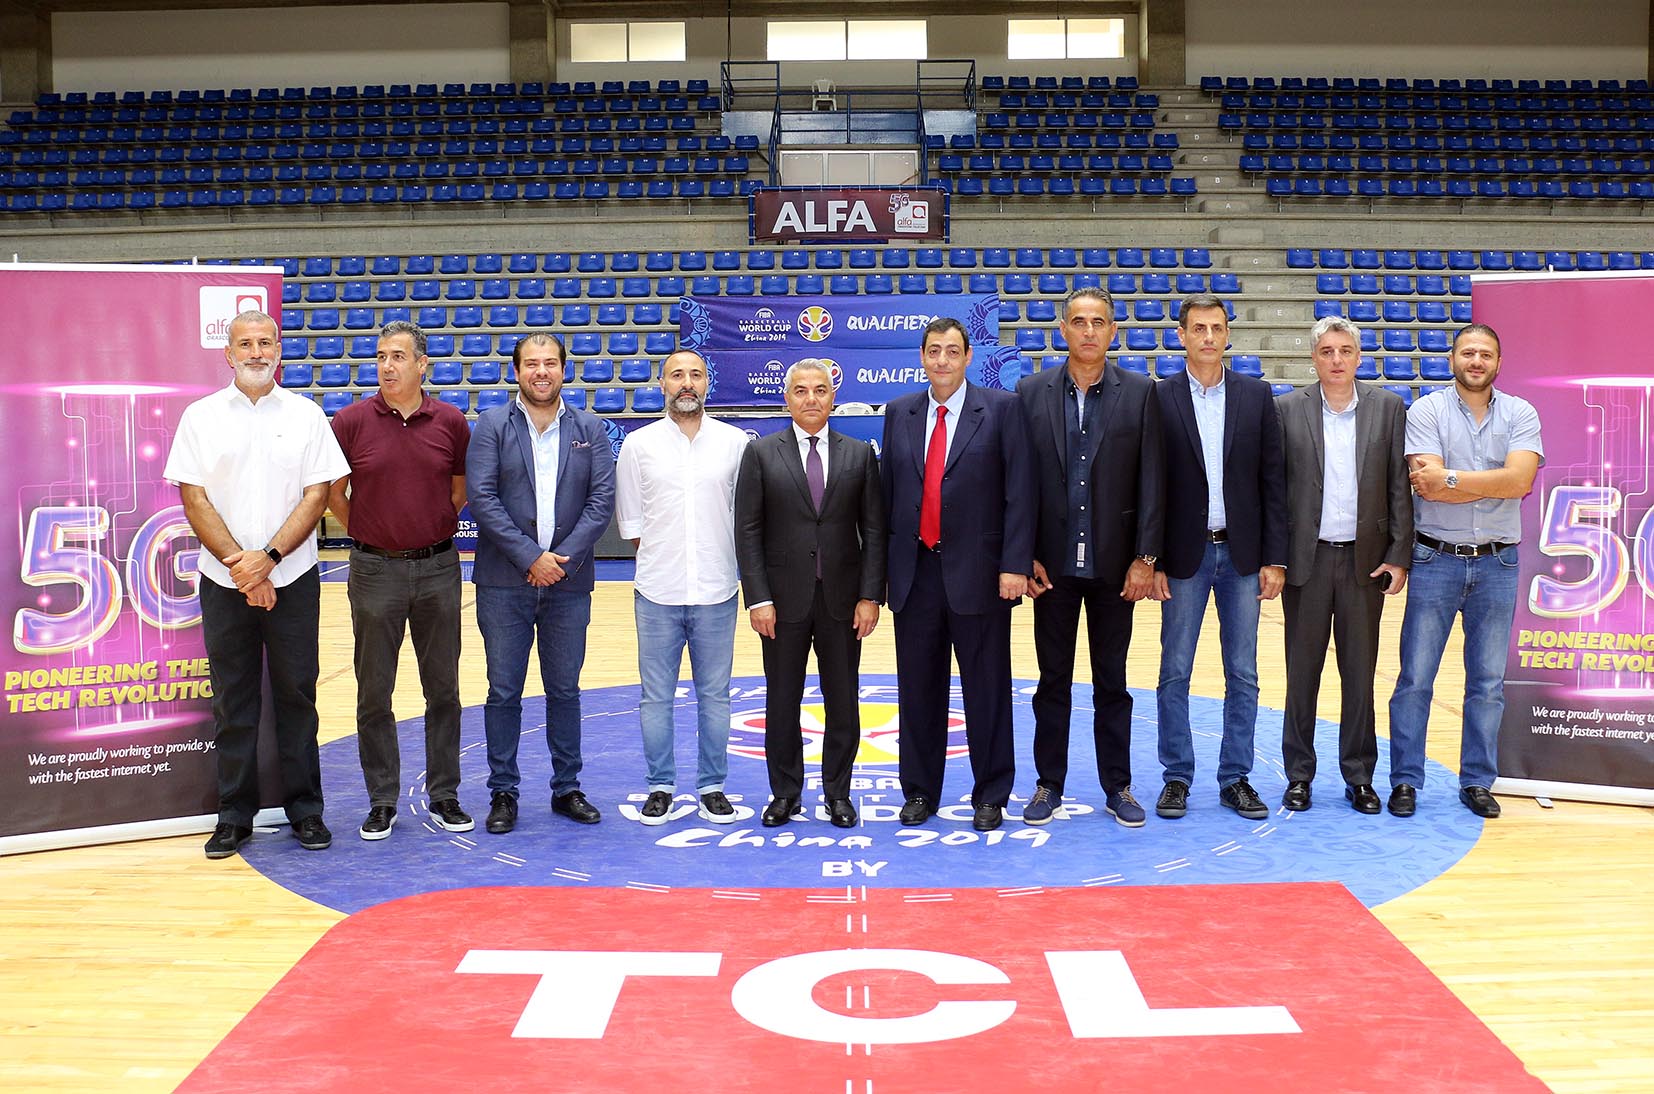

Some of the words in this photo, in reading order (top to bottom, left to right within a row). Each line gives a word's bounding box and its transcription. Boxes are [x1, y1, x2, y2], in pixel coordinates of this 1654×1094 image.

[888, 193, 910, 214] 5G
[771, 200, 877, 234] ALFA
[897, 217, 912, 226] alfa
[759, 311, 771, 319] FIBA
[739, 324, 772, 332] WORLD
[773, 324, 792, 332] CUP
[744, 333, 767, 342] China
[768, 333, 786, 341] 2019
[748, 377, 781, 385] WORLD
[753, 386, 776, 394] China
[13, 505, 203, 655] 5G
[1517, 629, 1654, 652] PIONEERING
[1518, 650, 1575, 670] TECH
[4, 661, 158, 691] PIONEERING
[166, 657, 211, 678] THE
[7, 690, 72, 713] TECH
[1532, 706, 1549, 718] We
[1549, 708, 1565, 719] are
[1566, 708, 1604, 724] proudly
[1605, 710, 1646, 726] working
[1531, 723, 1553, 735] with
[1554, 723, 1570, 736] the
[1570, 724, 1604, 739] fastest
[1605, 727, 1644, 740] internet
[28, 752, 46, 766] We
[48, 754, 66, 765] are
[67, 746, 109, 767] proudly
[109, 743, 151, 759] working
[153, 742, 164, 755] to
[165, 738, 203, 757] provide
[28, 770, 53, 785] with
[55, 768, 73, 783] the
[74, 765, 109, 784] fastest
[111, 763, 151, 777] internet
[152, 761, 171, 776] yet.
[807, 778, 900, 790] FBA
[655, 827, 873, 849] China
[898, 828, 1051, 848] 2019
[822, 859, 888, 877] BY
[455, 948, 1303, 1044] TCL
